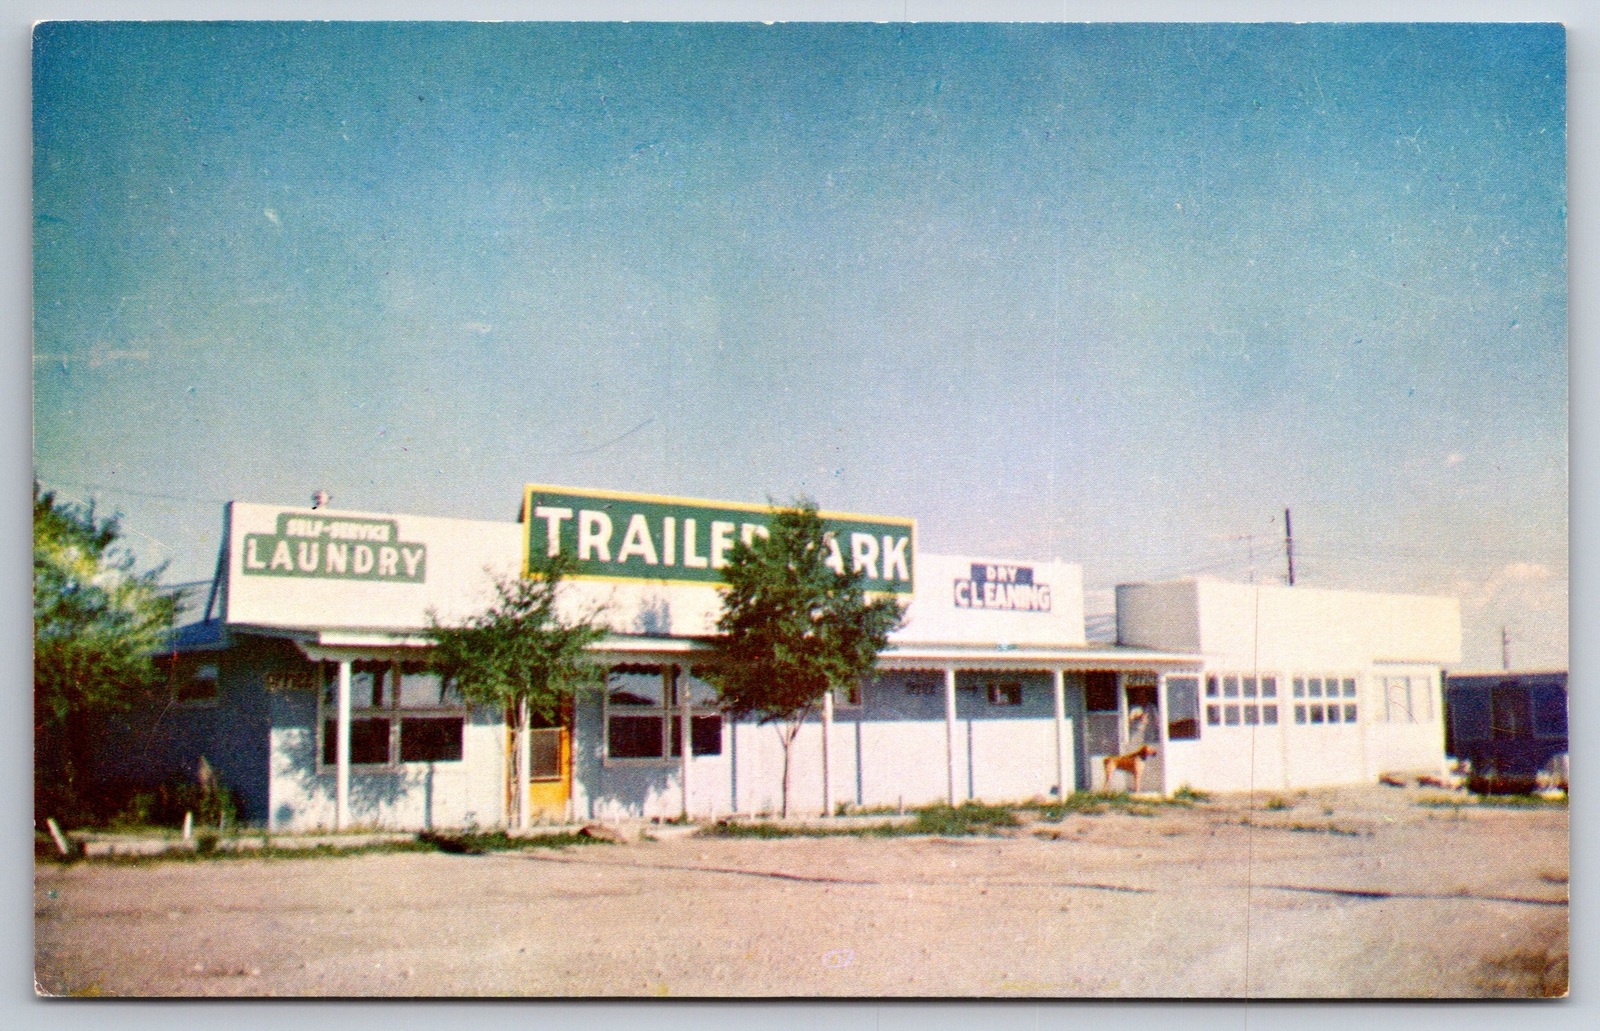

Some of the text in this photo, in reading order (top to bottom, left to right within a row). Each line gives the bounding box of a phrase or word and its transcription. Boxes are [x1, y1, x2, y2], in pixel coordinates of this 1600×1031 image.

[246, 537, 424, 578] LAUNDRY
[789, 527, 910, 581] ARK
[985, 565, 1018, 582] DRY
[954, 581, 1050, 610] CLEANING
